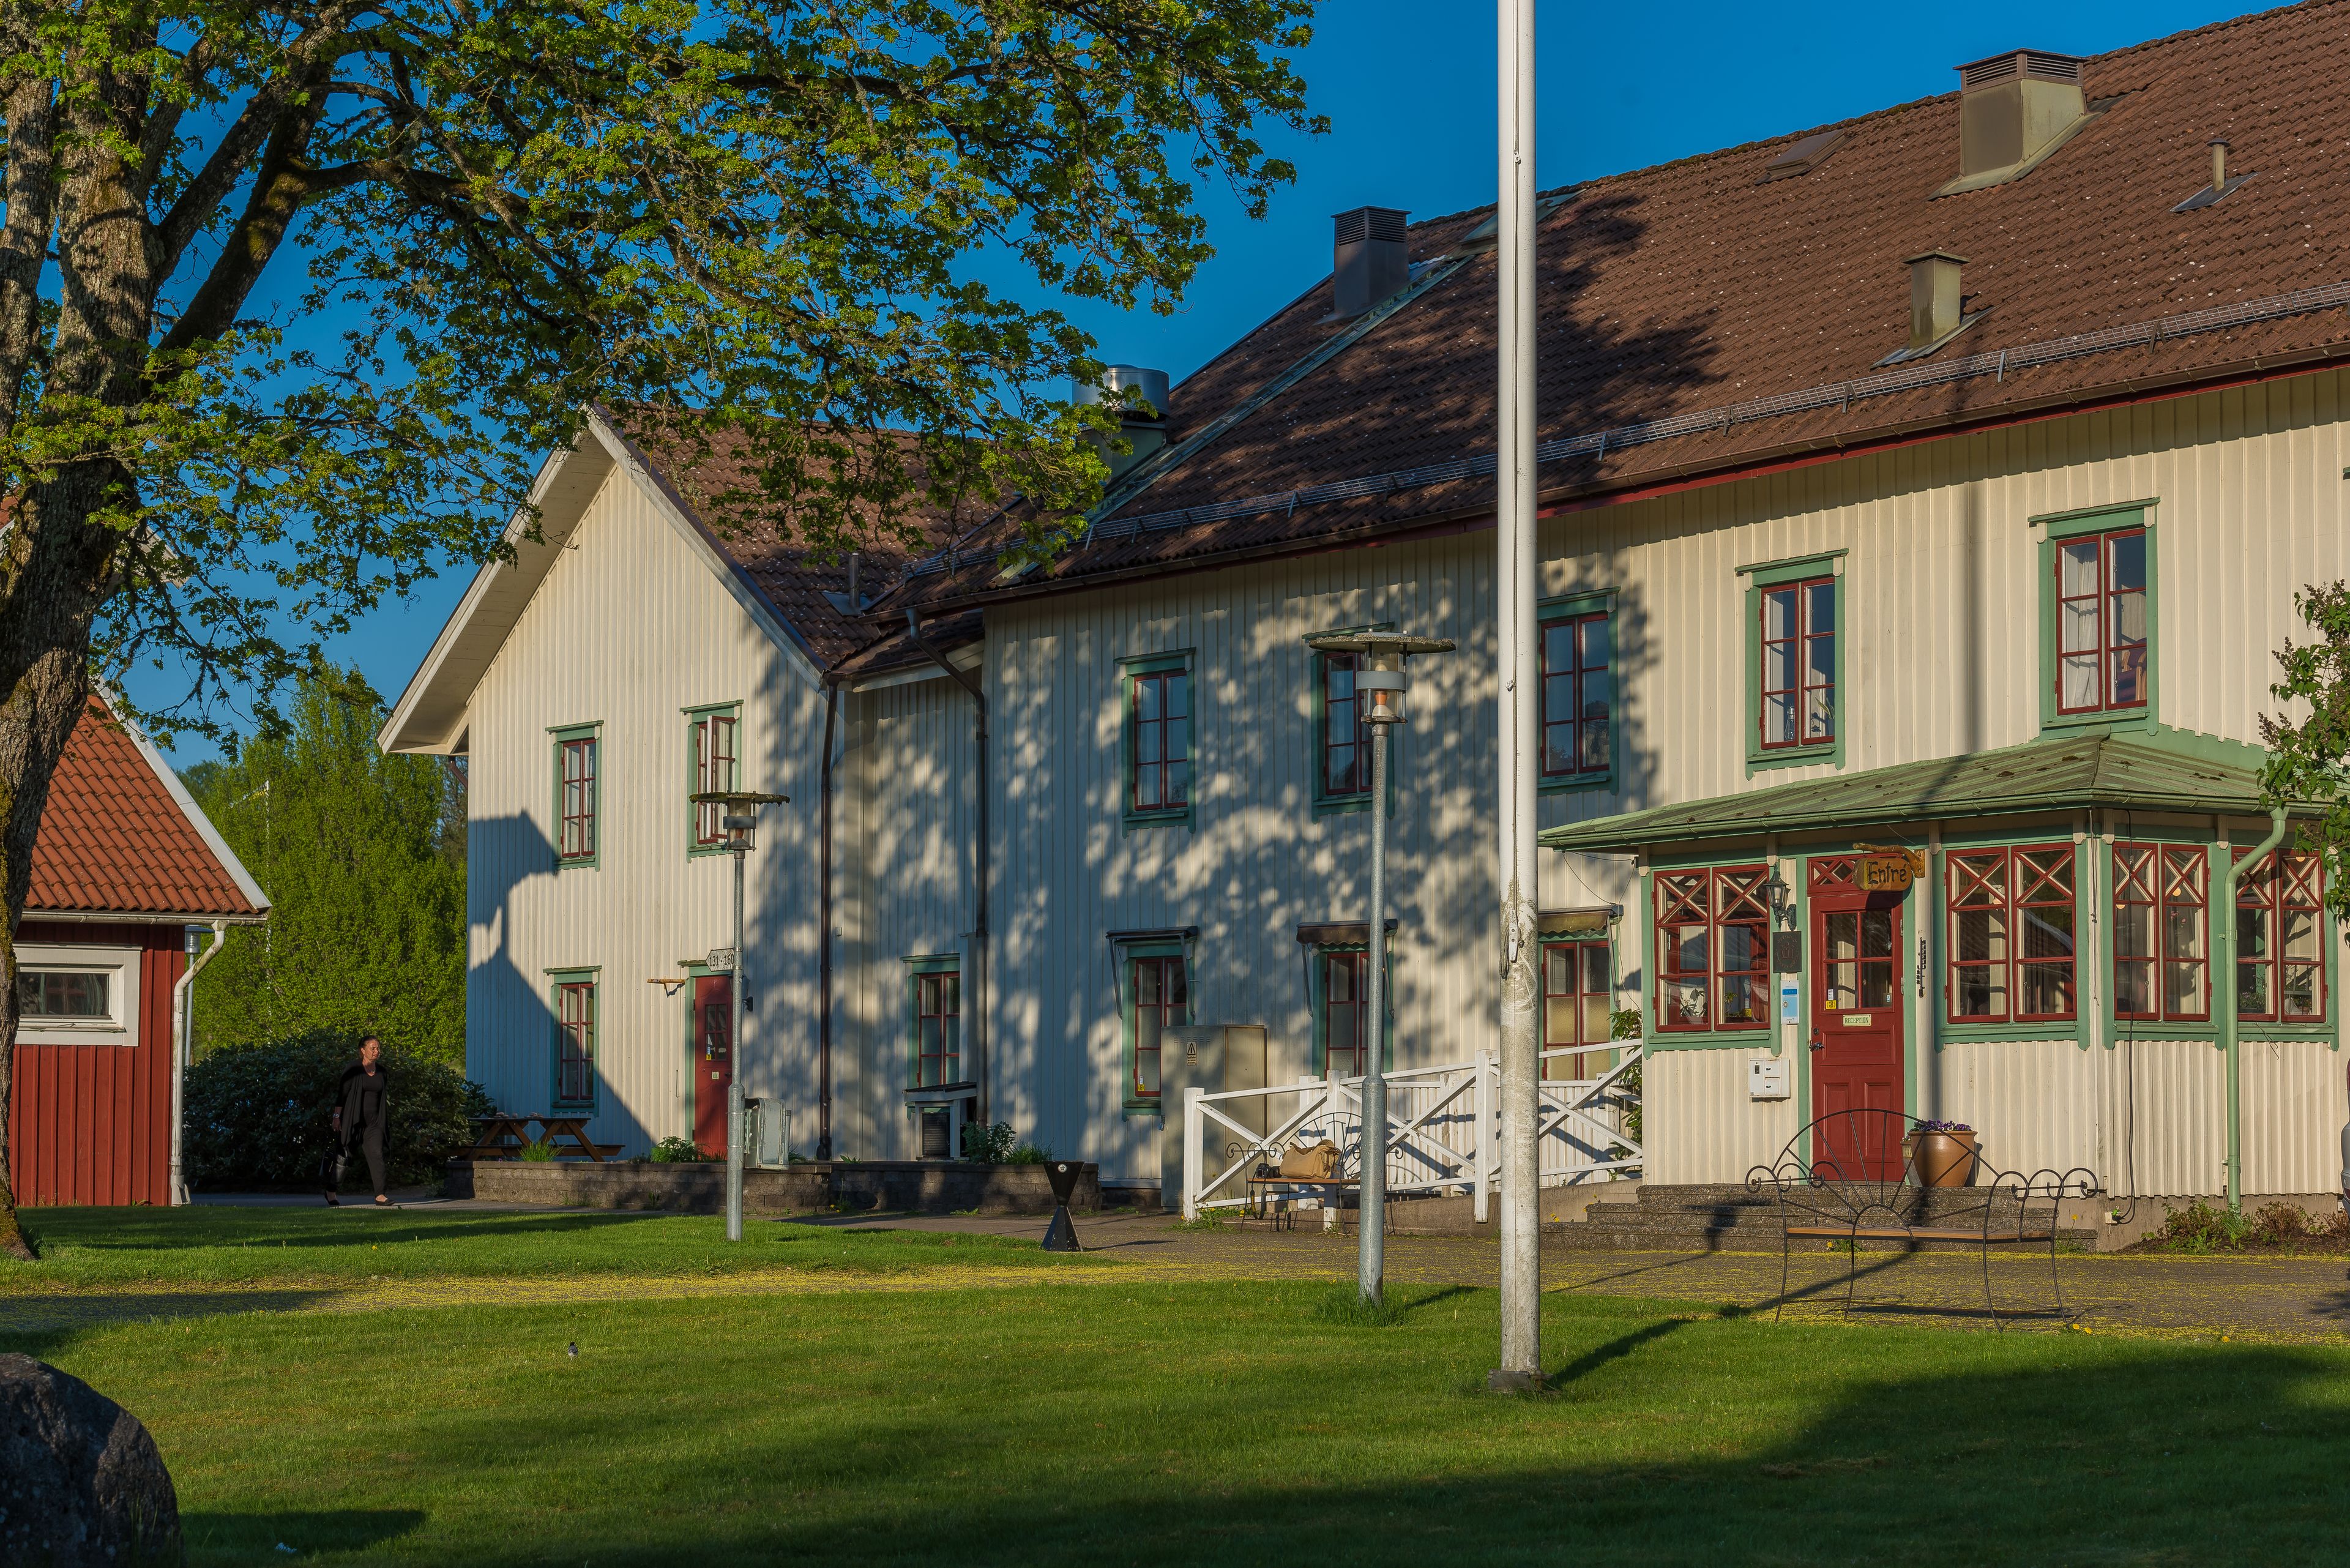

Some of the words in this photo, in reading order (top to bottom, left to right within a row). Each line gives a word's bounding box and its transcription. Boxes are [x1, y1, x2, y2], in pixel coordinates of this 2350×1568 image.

[1867, 861, 1907, 884] Entré
[710, 955, 718, 967] 131
[724, 954, 734, 965] 160
